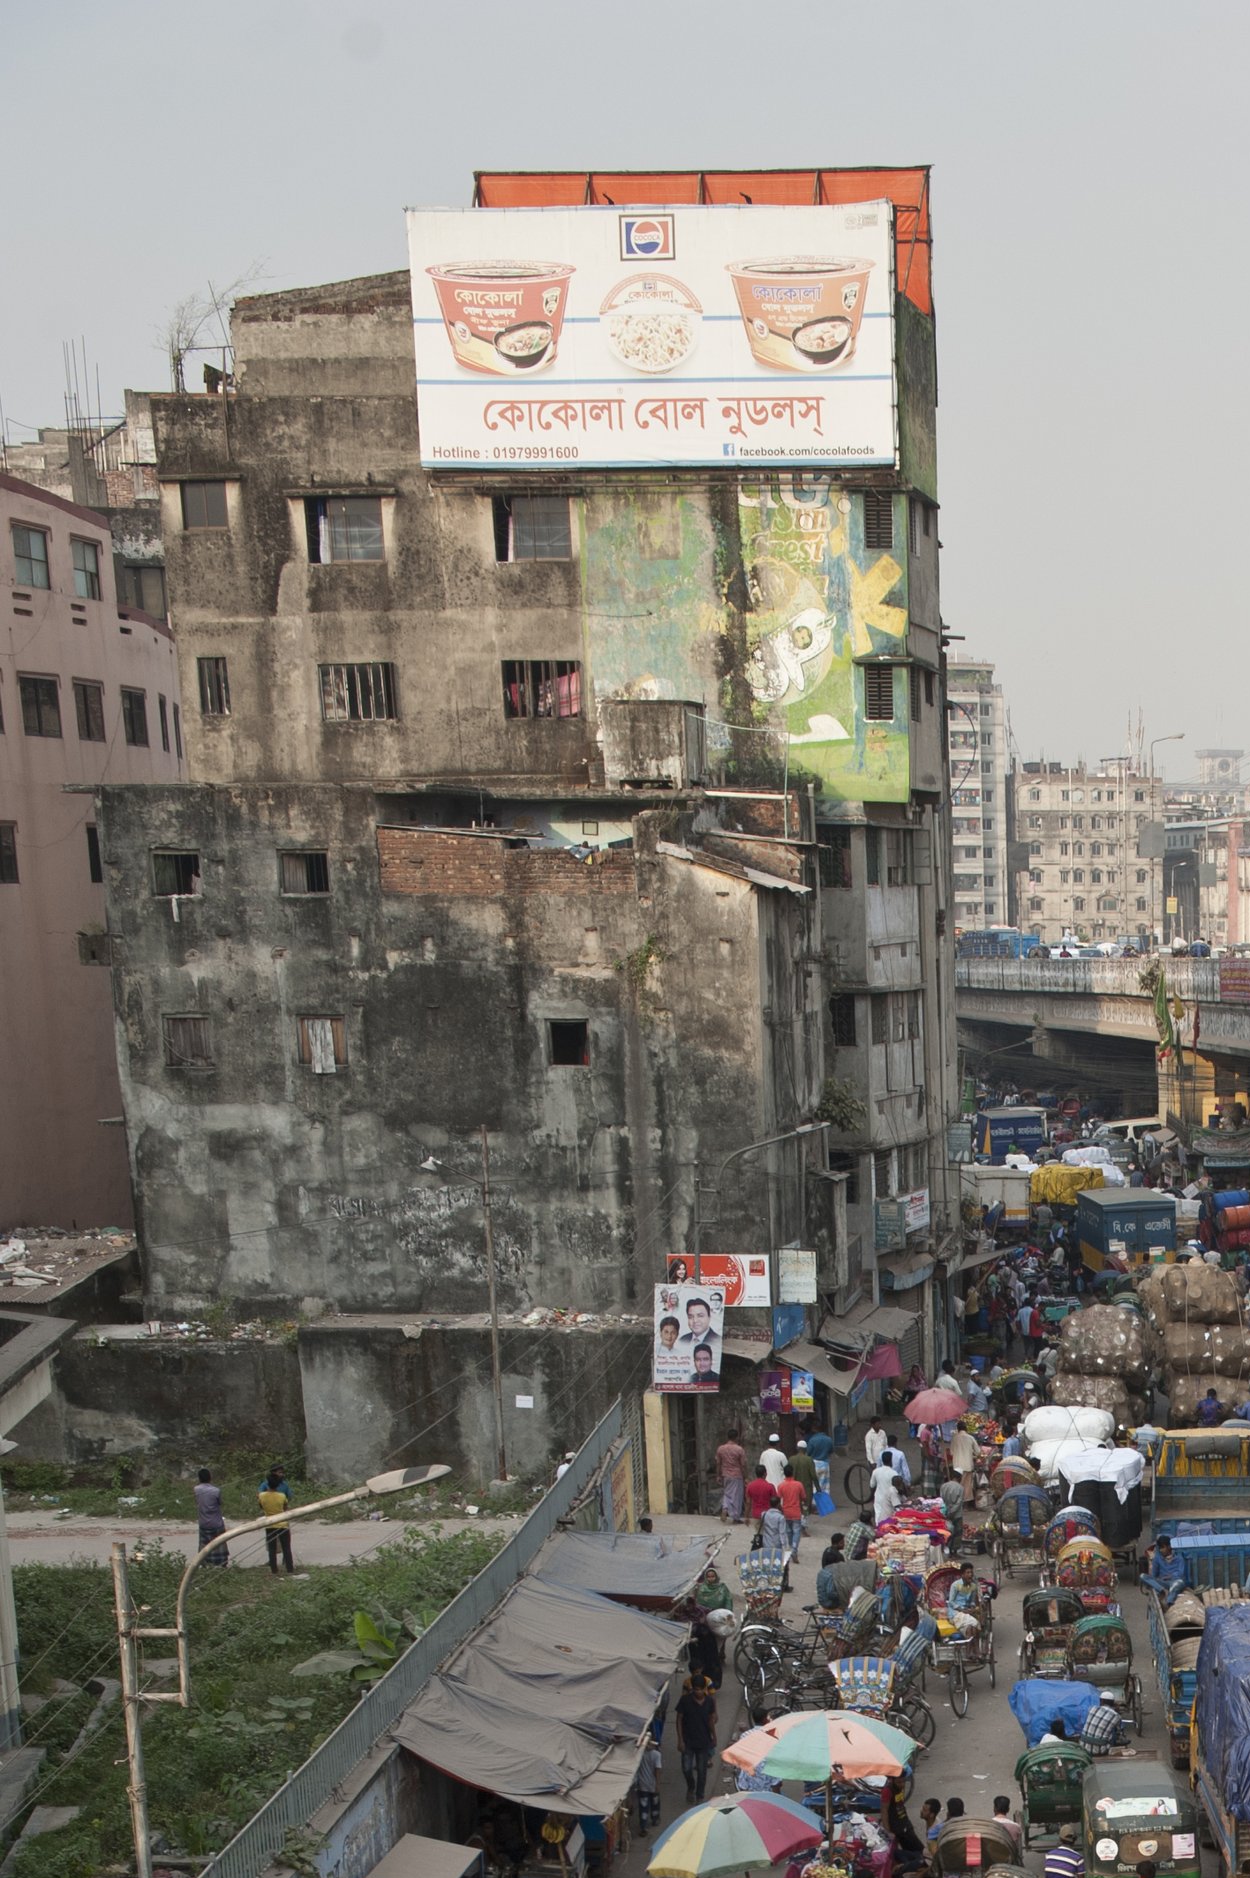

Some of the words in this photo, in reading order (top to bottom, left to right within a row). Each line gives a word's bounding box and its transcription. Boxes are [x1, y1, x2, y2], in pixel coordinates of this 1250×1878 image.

[634, 233, 660, 241] COCOLA
[454, 288, 523, 306] কোকোলা
[629, 290, 674, 299] কোকোলা
[752, 283, 823, 301] কোকোলা
[483, 398, 626, 432] কোকোলা
[634, 397, 709, 430] বোল
[716, 396, 827, 438] নুডলস্
[432, 446, 481, 459] Hotline
[493, 446, 579, 459] 01979991600
[739, 446, 876, 457] facebook.com/cocolafoods
